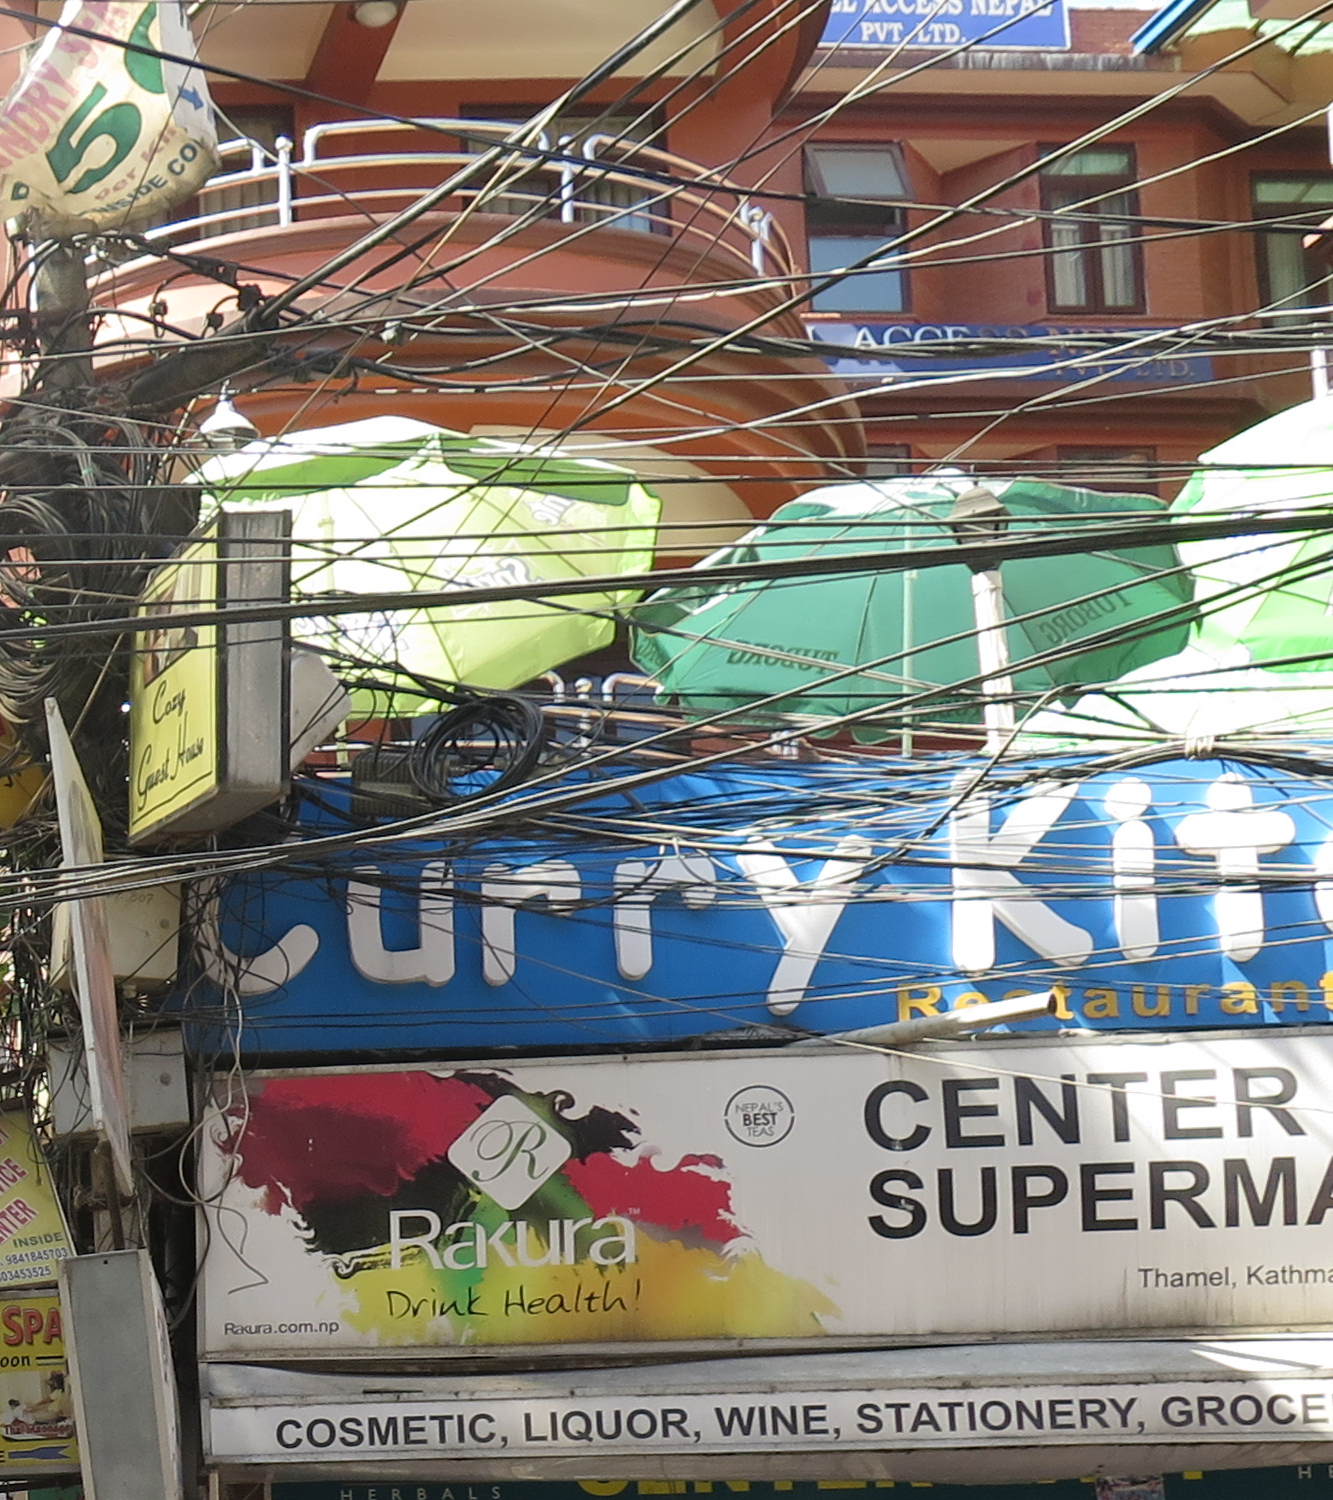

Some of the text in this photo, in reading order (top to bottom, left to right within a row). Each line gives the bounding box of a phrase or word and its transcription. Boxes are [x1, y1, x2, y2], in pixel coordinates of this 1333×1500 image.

[740, 1112, 779, 1128] BEST
[863, 1065, 1309, 1152] CENTER
[745, 1124, 777, 1138] TEAS
[13, 1232, 64, 1249] INSIDE
[389, 1208, 639, 1271] Rakura
[386, 1281, 643, 1319] Drink Health!
[1, 1305, 63, 1347] SPA
[223, 1317, 341, 1341] Rakura.com.np
[276, 1395, 1147, 1450] COSMETIC, LIQUOR, WINE, STATIONERY,
